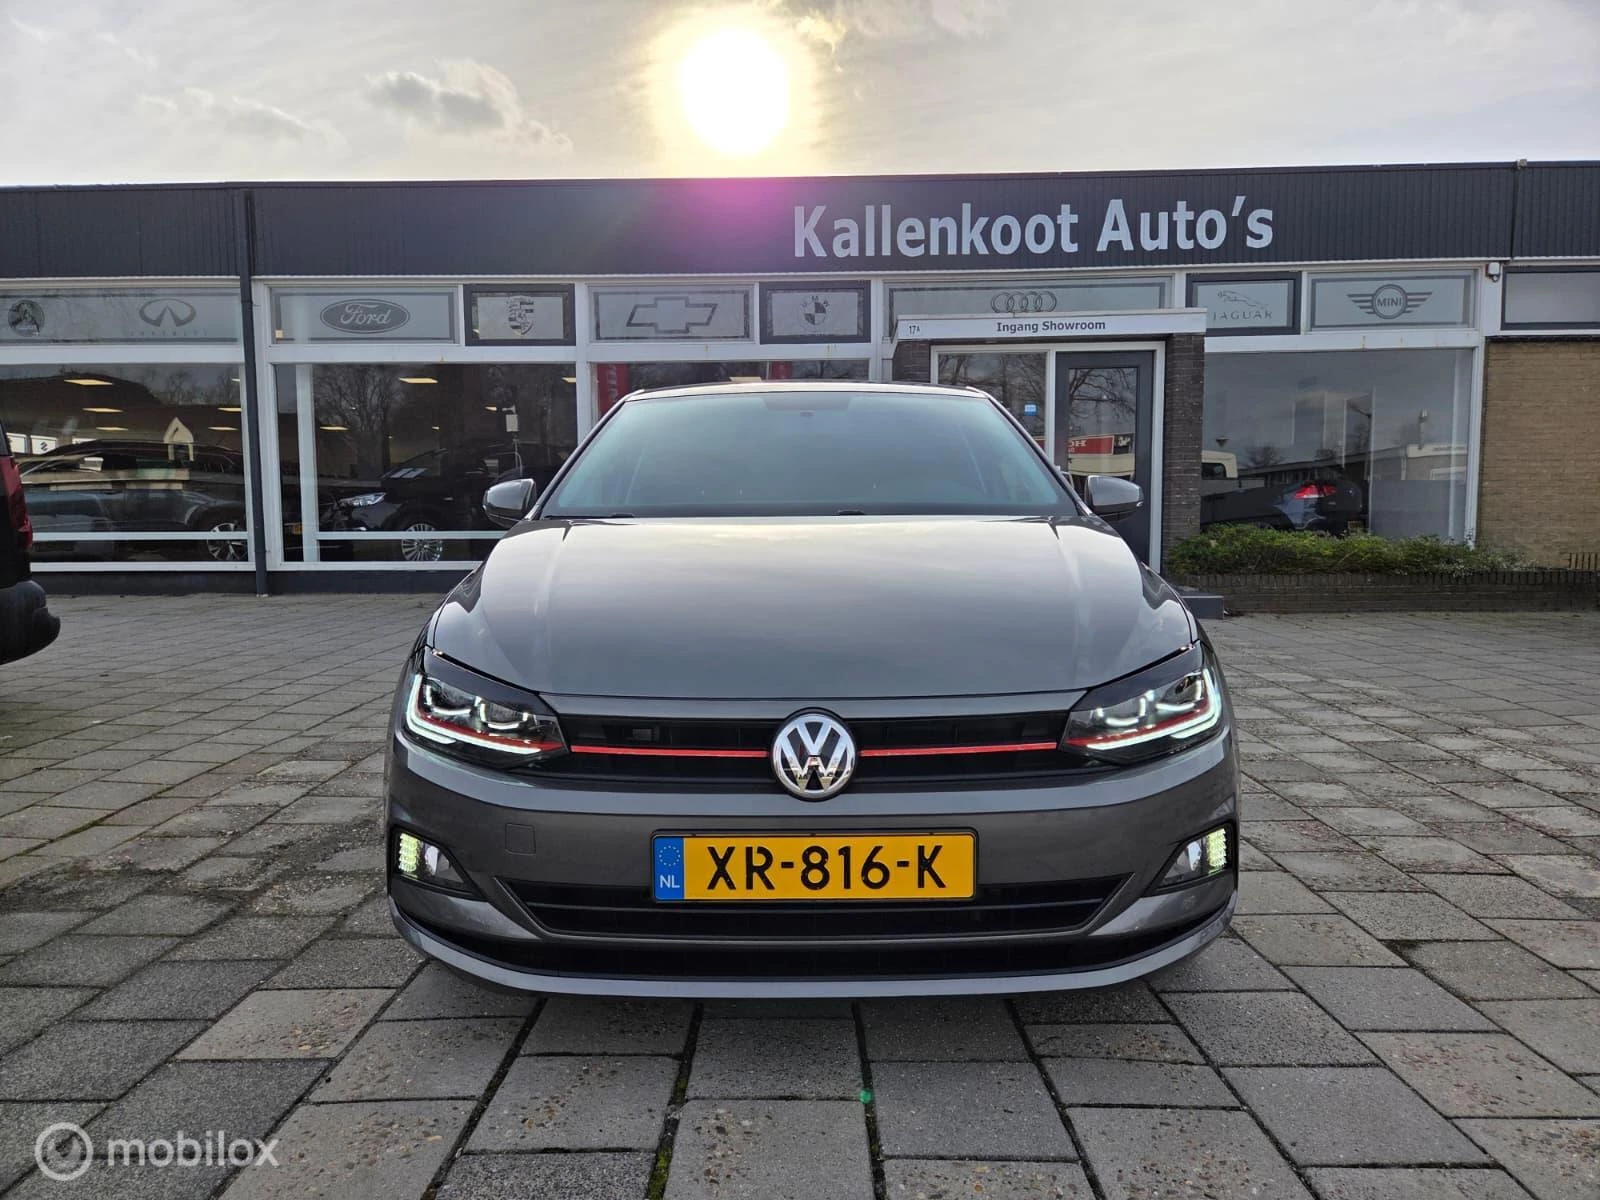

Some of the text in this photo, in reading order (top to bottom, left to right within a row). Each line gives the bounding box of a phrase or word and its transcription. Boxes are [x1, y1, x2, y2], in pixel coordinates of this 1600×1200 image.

[793, 195, 1274, 258] Kallenkoot Auto's
[1377, 297, 1402, 307] MINI
[340, 303, 392, 325] Ford
[1213, 310, 1273, 321] JAGUAR
[997, 320, 1106, 333] Ingang Showroom
[707, 845, 947, 891] XR-816-K
[659, 874, 681, 889] NL
